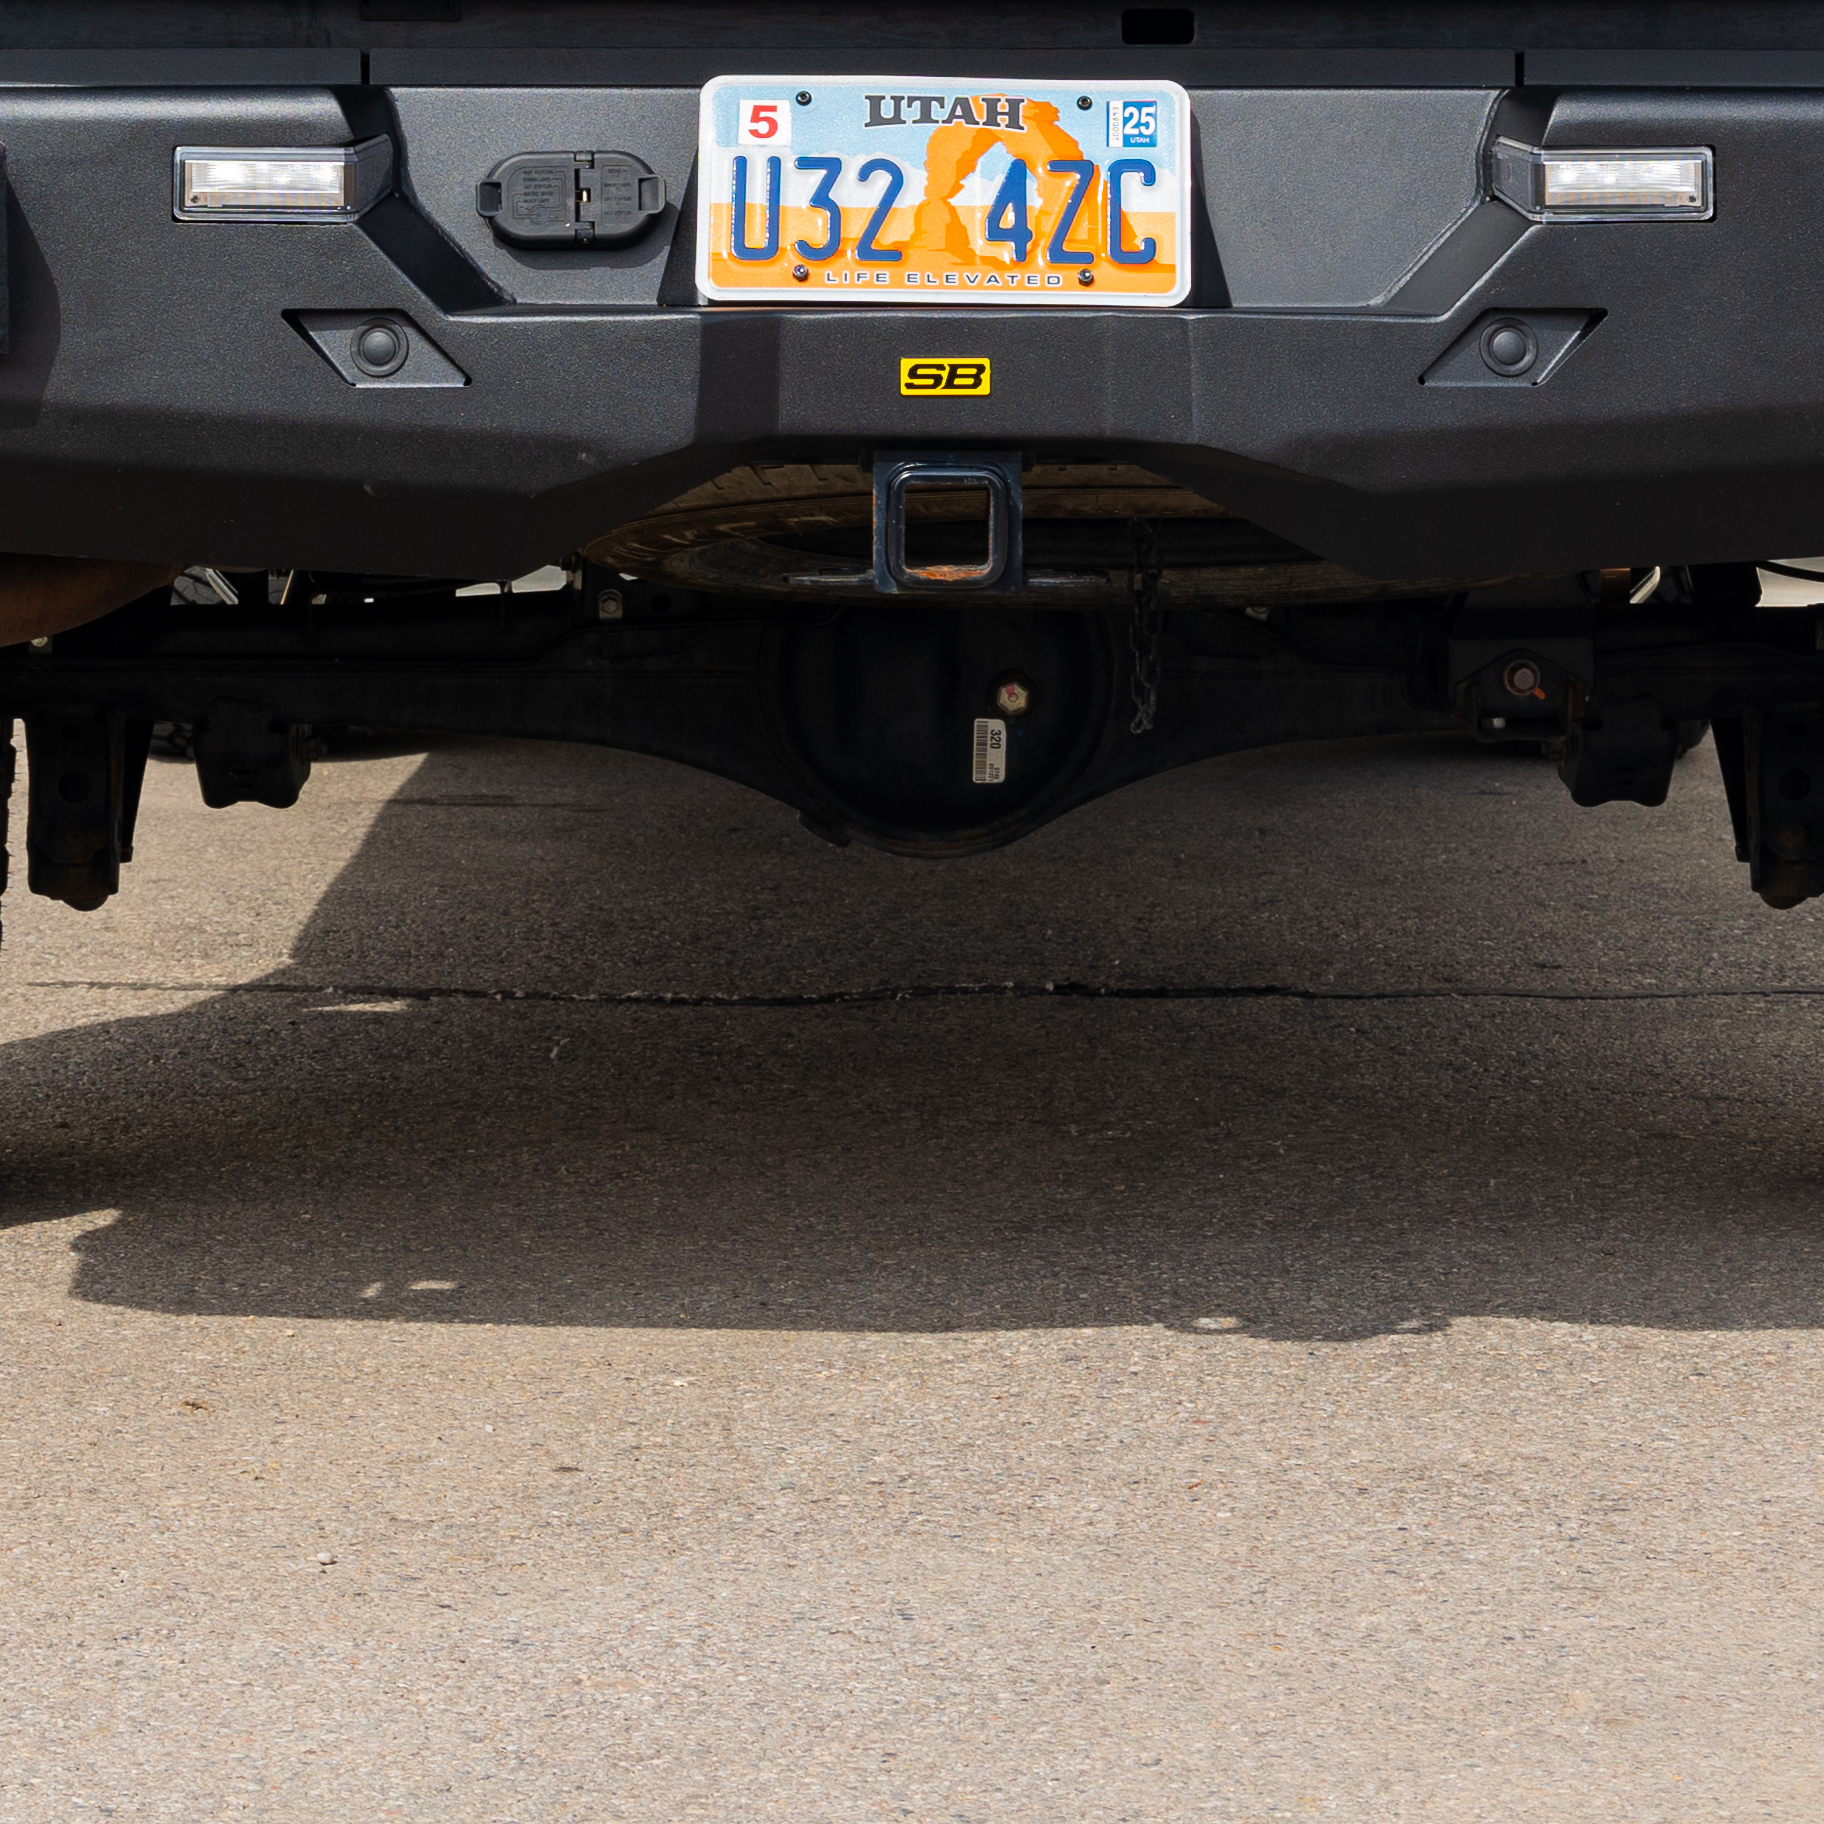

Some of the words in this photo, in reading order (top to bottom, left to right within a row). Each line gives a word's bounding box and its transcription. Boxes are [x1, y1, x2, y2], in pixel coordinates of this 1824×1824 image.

[747, 104, 779, 139] 5
[862, 94, 1027, 132] UTAH
[1123, 106, 1156, 136] 25
[1129, 136, 1151, 144] UTAH
[730, 155, 905, 262] U32
[985, 157, 1158, 265] 4ZC
[825, 271, 889, 284] LIFE
[906, 272, 1062, 287] ELEVATED
[904, 363, 987, 391] SB
[990, 729, 1002, 749] 320
